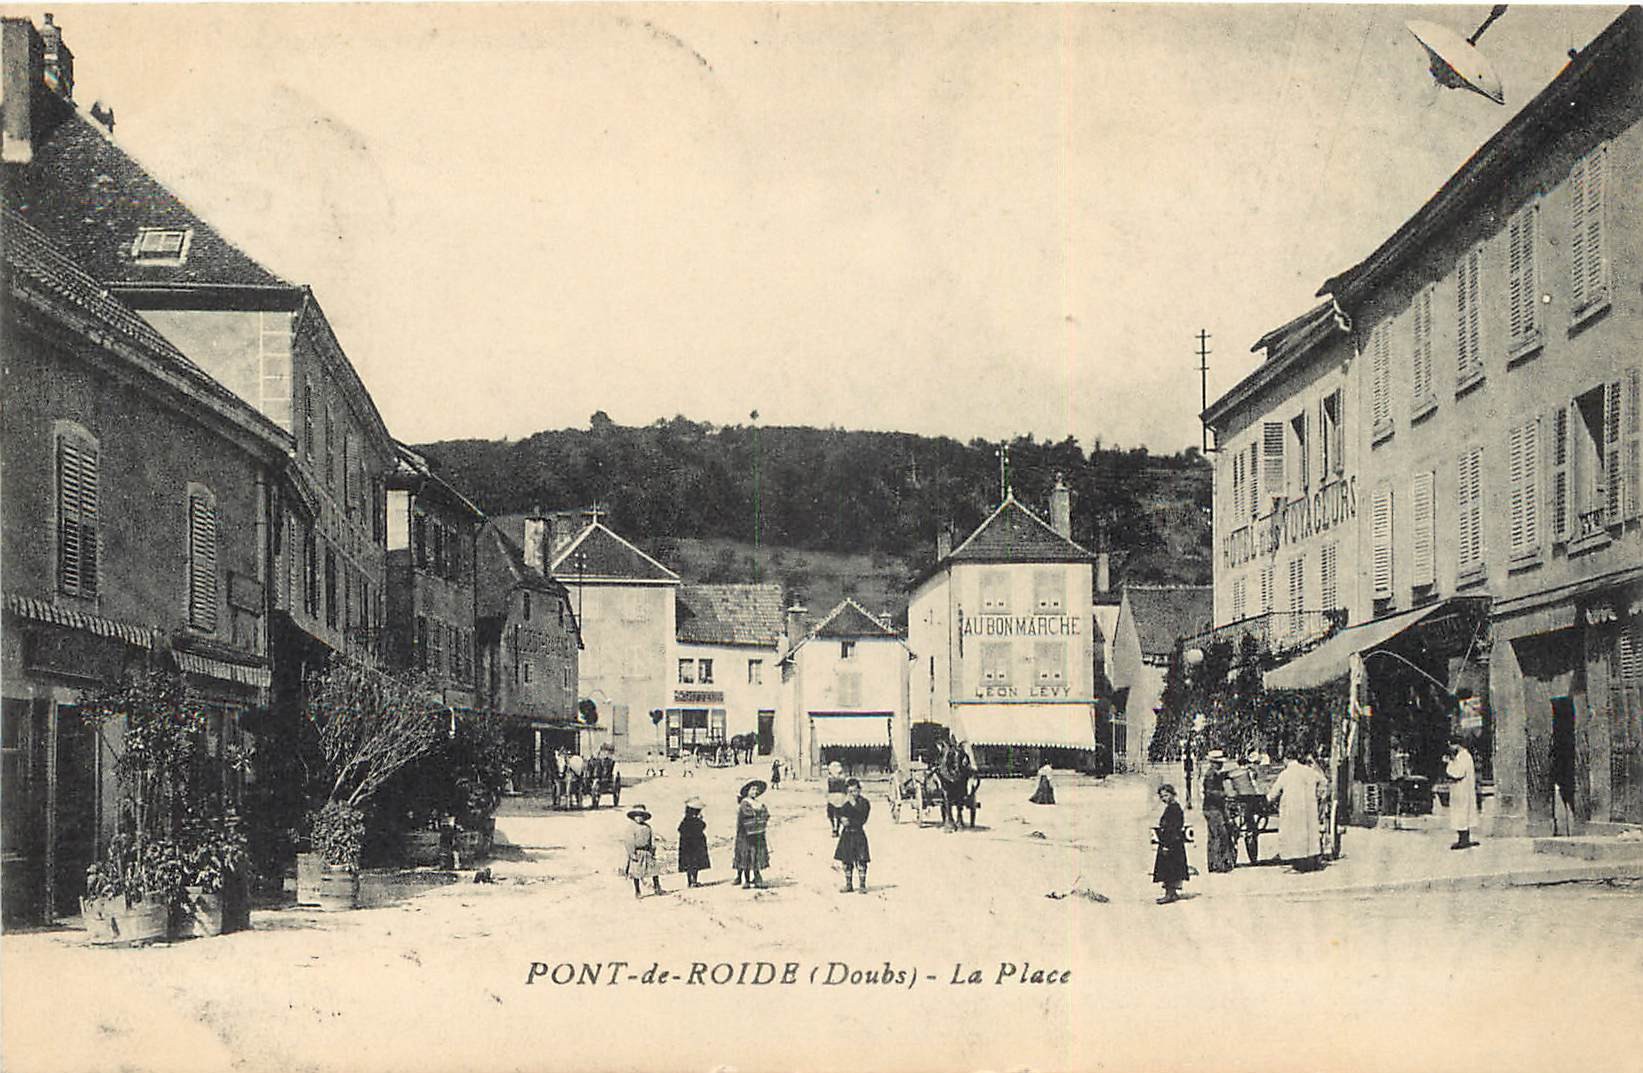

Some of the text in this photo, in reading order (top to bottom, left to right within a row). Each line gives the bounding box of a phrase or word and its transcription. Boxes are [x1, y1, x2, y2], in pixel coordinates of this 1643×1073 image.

[1282, 475, 1357, 545] VOYAGEURS
[964, 617, 983, 636] AU
[987, 617, 1013, 636] BON
[1030, 687, 1072, 698] LEVY
